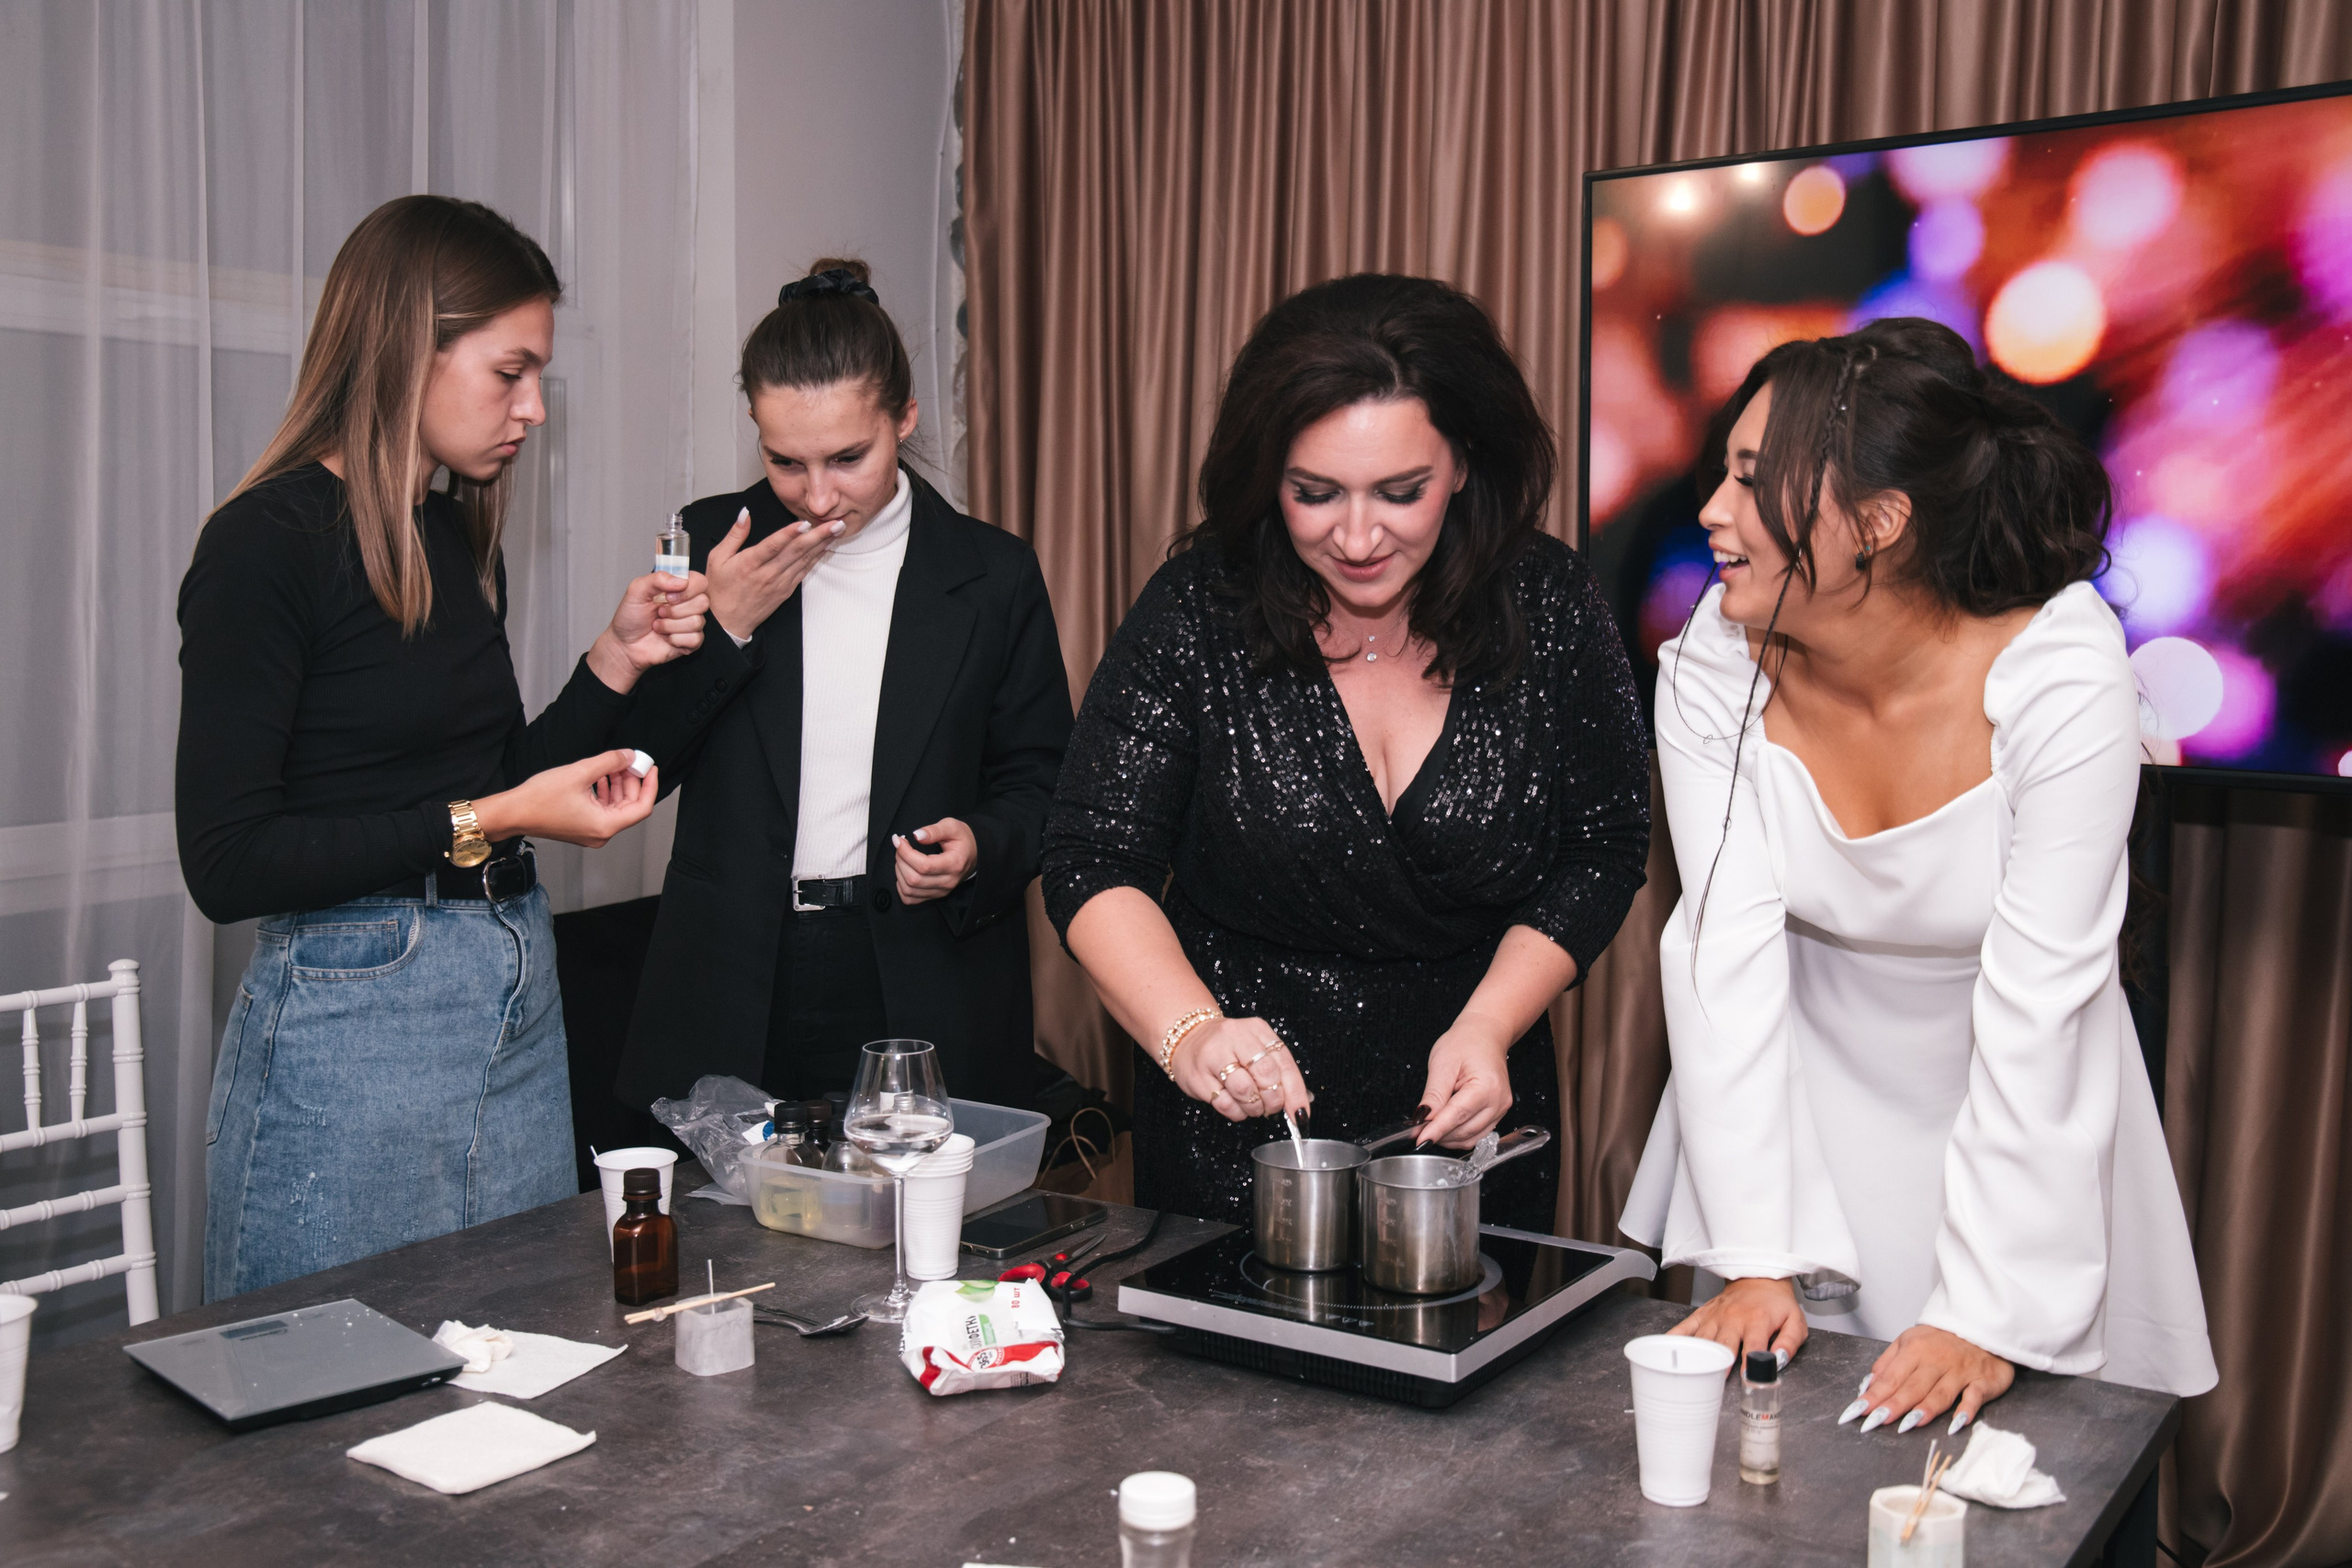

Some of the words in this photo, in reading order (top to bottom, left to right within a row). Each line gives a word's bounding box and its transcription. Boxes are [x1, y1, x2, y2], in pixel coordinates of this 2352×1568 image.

[1013, 1287, 1021, 1298] шт
[1011, 1300, 1020, 1309] 80
[977, 1352, 989, 1369] 365
